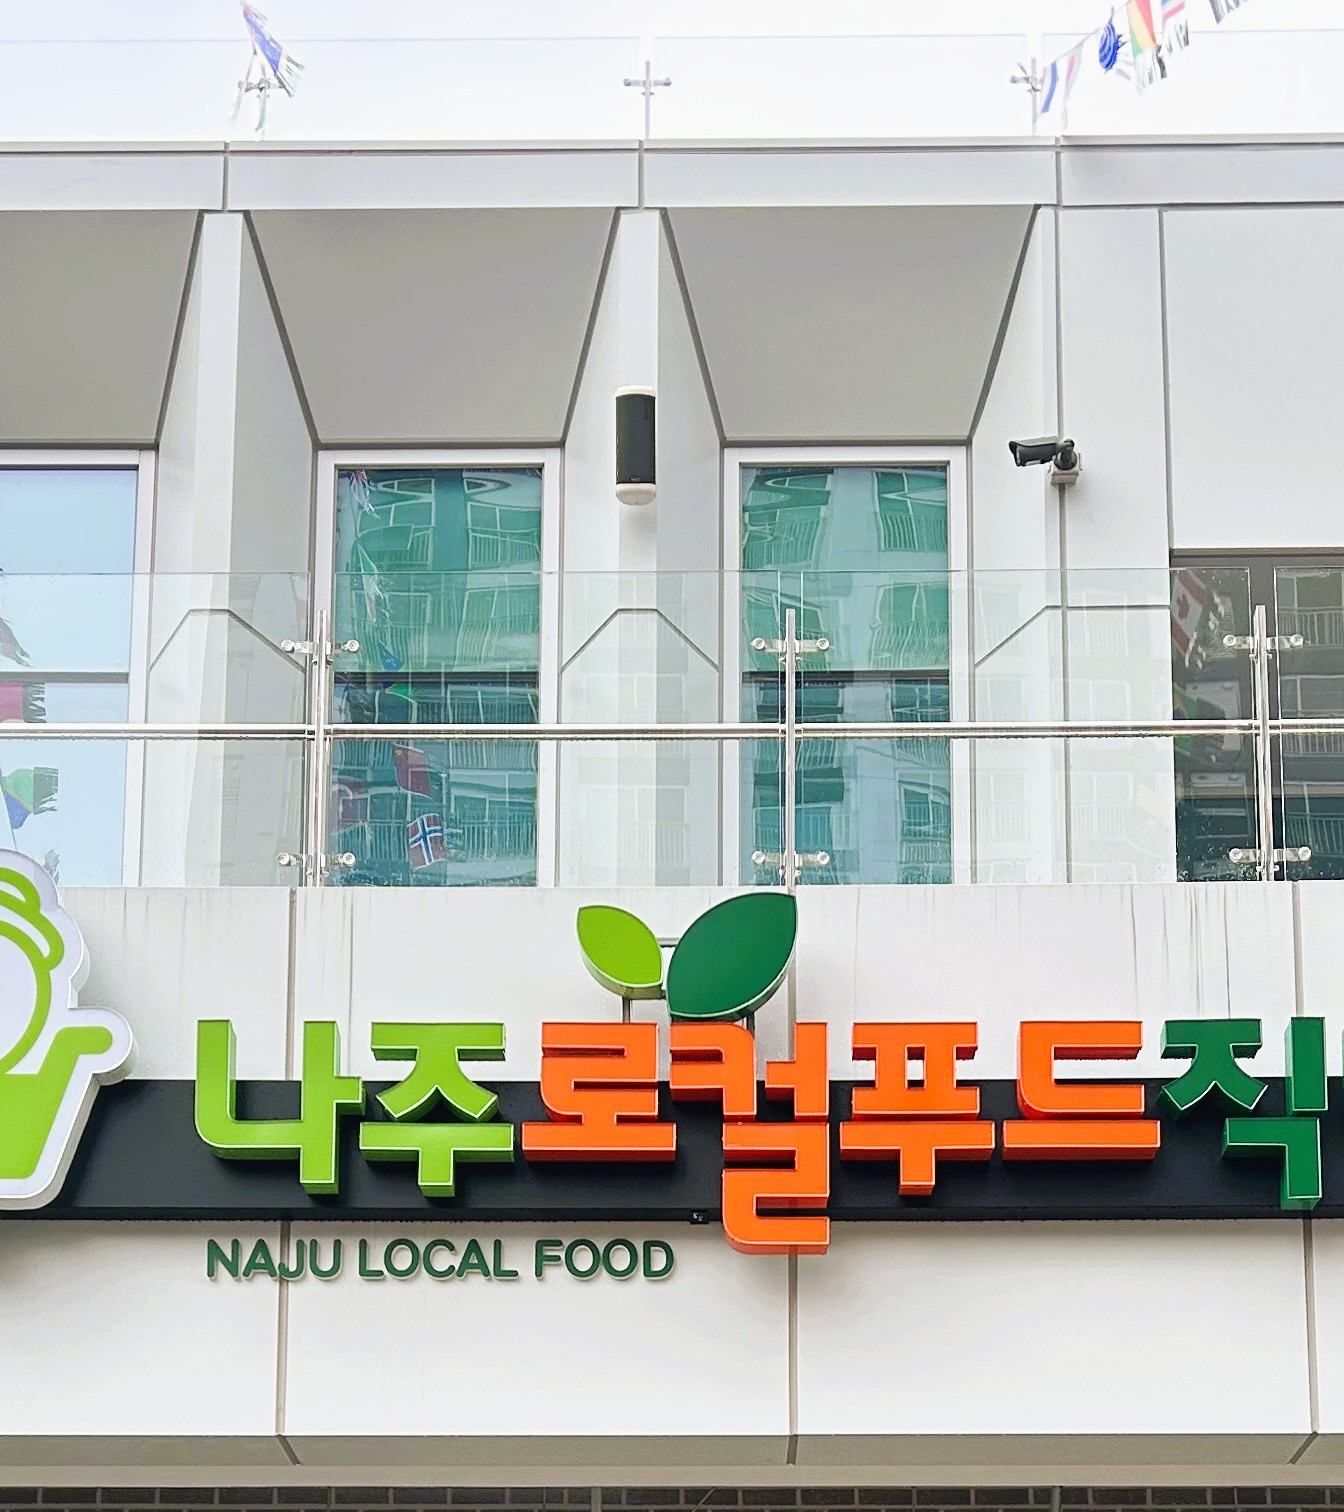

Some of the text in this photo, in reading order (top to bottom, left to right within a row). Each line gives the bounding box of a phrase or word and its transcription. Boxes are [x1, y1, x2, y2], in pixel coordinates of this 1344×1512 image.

[205, 1238, 676, 1280] NAJU LOCAL FOOD
